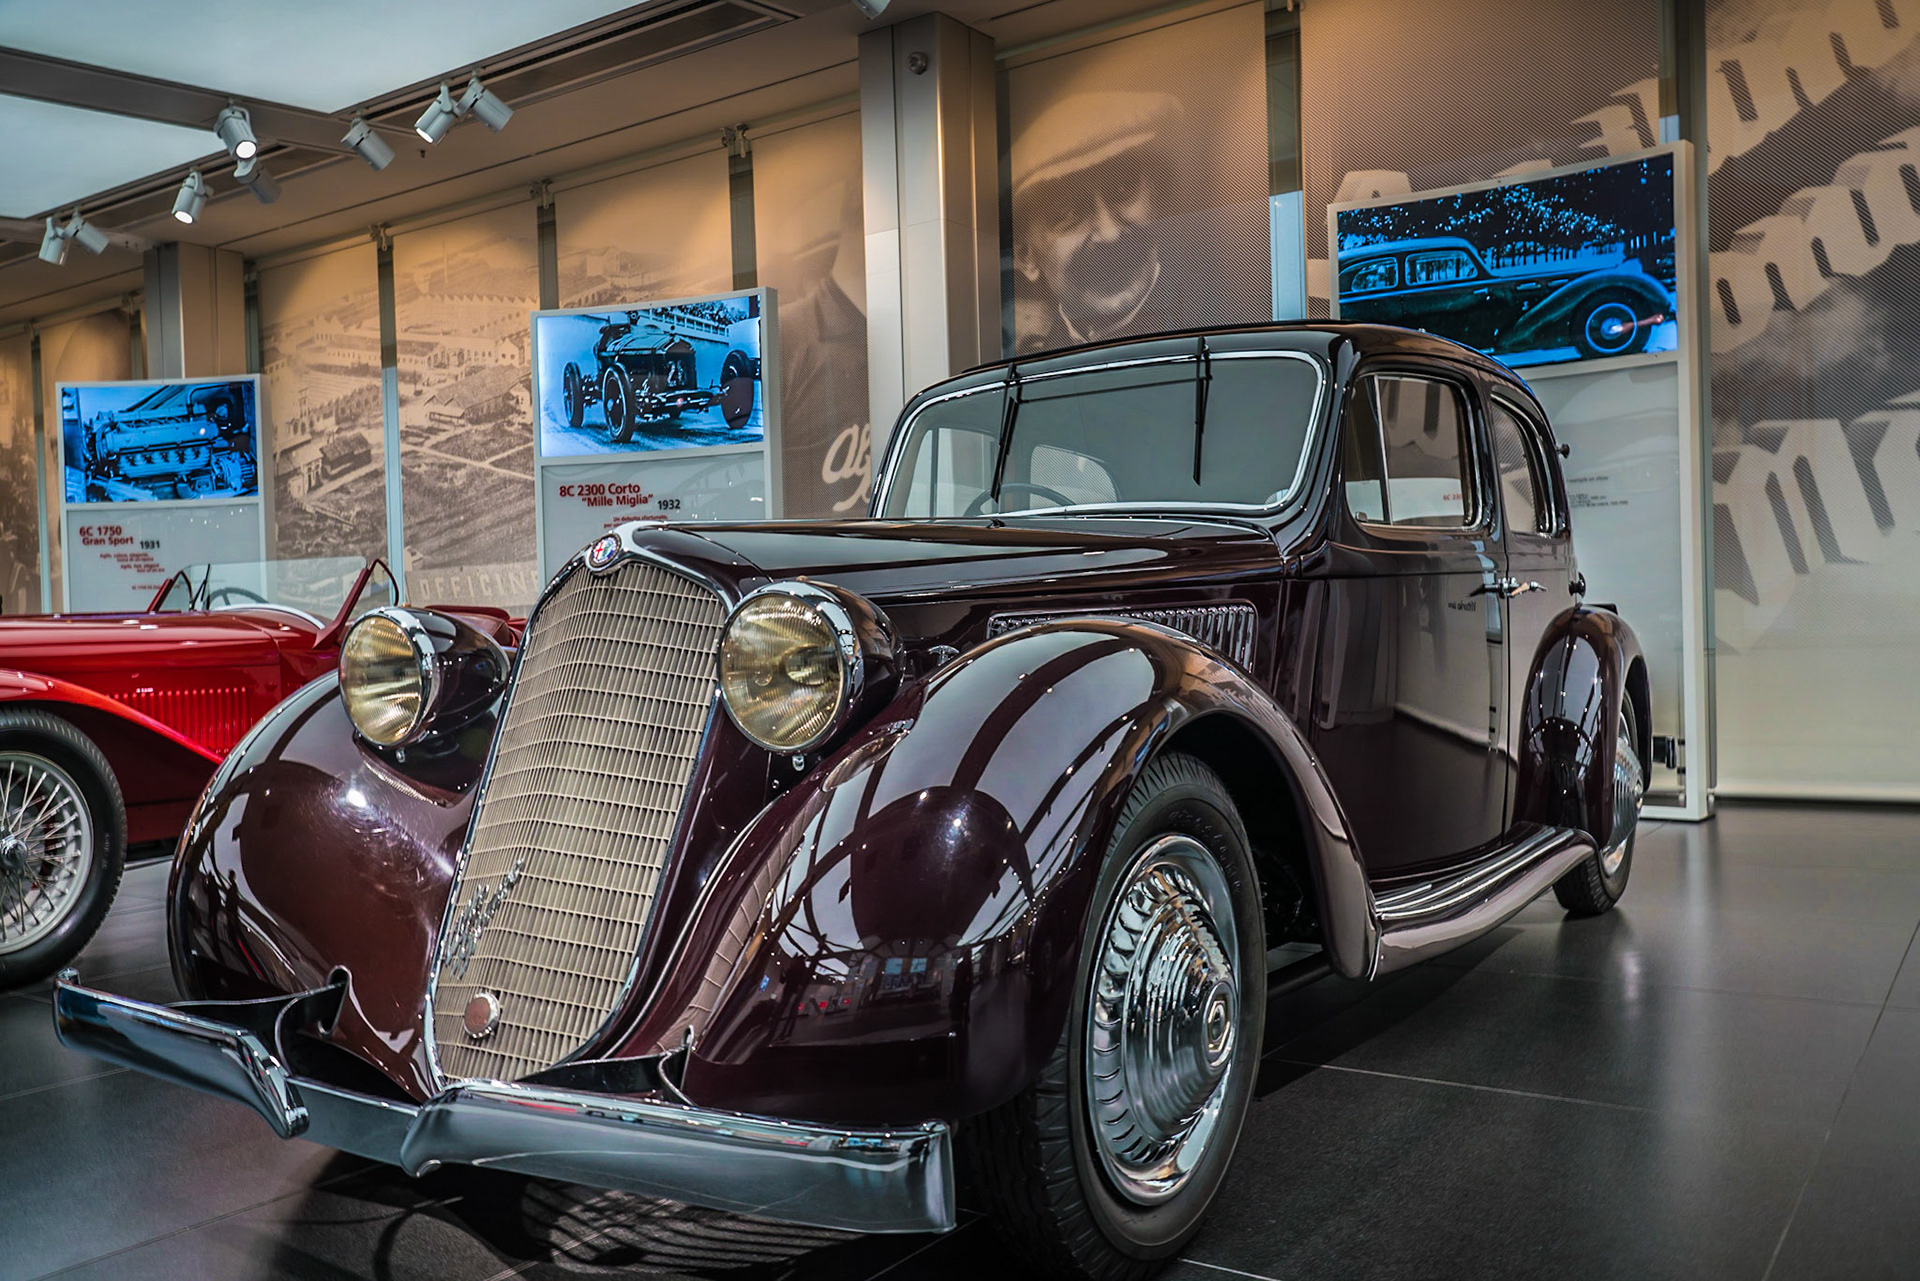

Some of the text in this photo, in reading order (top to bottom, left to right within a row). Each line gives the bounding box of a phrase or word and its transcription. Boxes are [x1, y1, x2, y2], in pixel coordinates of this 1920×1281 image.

[822, 424, 871, 512] Alf
[559, 483, 641, 497] 8C 2300 Corto
[581, 494, 653, 507] "Mille Miglia"
[657, 499, 681, 510] 1932
[79, 525, 122, 537] 6C 1750
[82, 536, 134, 547] Gran Sport
[140, 540, 160, 549] 1931
